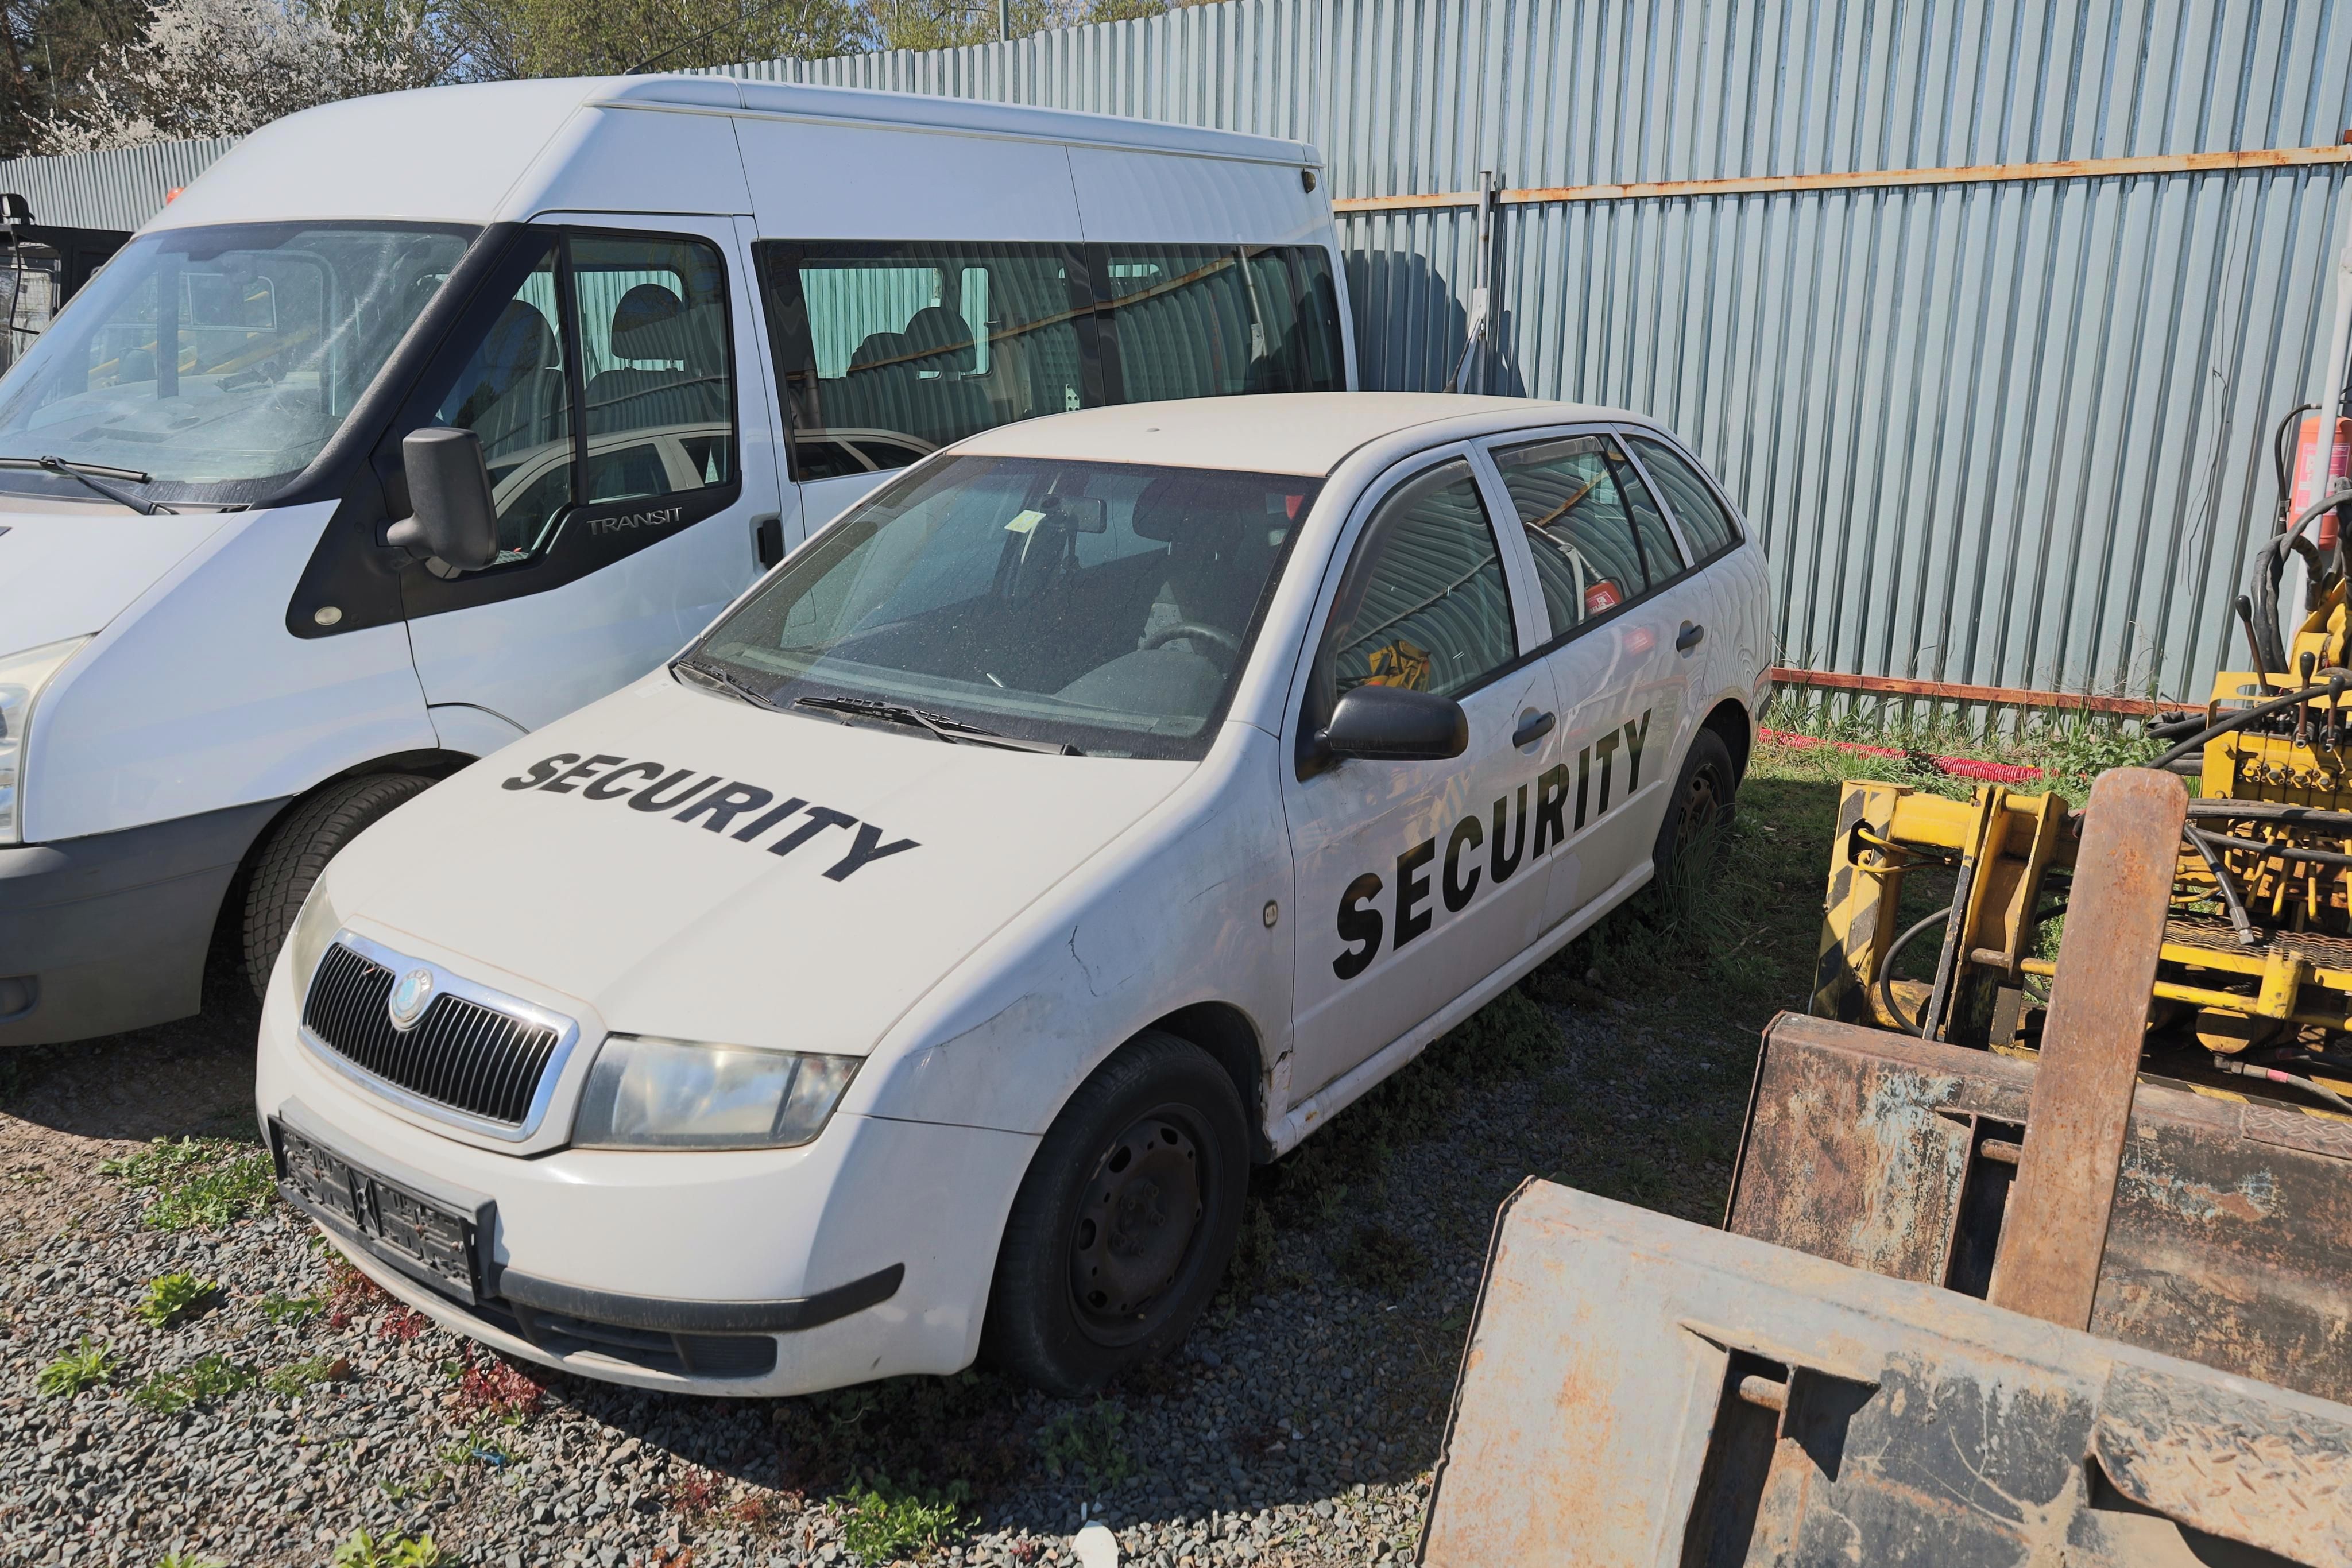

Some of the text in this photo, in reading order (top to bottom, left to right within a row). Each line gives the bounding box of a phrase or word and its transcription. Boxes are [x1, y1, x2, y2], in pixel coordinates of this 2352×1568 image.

[586, 506, 683, 535] TRANSIT
[501, 753, 923, 882] SECURITY
[1332, 707, 1652, 980] SECURITY
